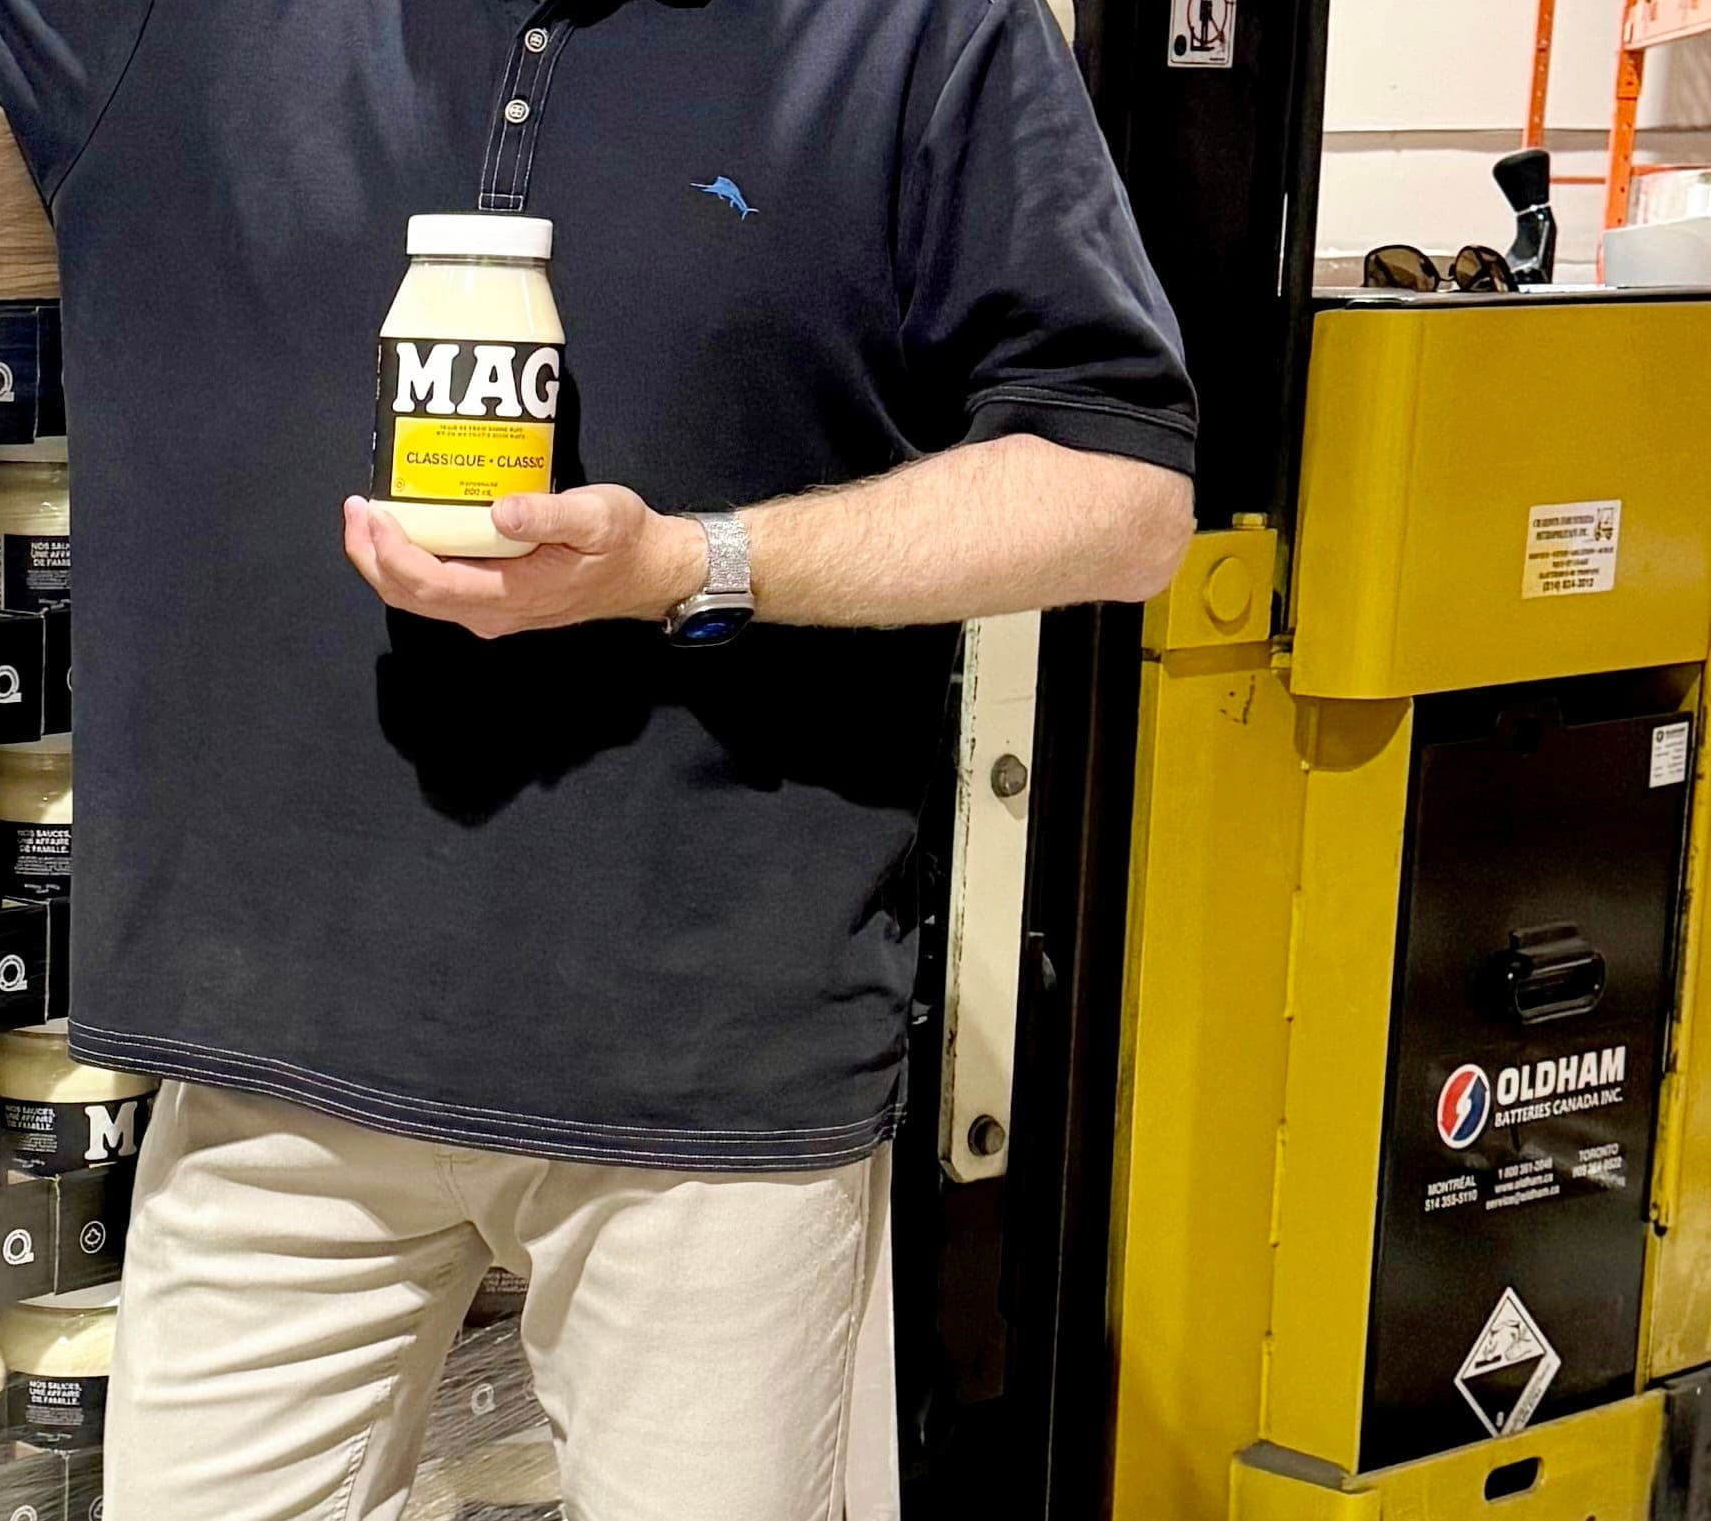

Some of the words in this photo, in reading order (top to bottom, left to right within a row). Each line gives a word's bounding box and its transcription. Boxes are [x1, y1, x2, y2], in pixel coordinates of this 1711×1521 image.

[392, 342, 560, 419] MAG
[407, 452, 486, 468] CLASSIQUE
[497, 455, 545, 469] CLASSIC
[1496, 1046, 1626, 1106] OLDHAM
[1494, 1101, 1551, 1128] BATTERIES
[1552, 1092, 1598, 1115] CANADA
[1600, 1087, 1624, 1105] INC.
[1578, 1142, 1620, 1162] TORONTO
[1427, 1174, 1477, 1196] MONTRÉAL
[1425, 1197, 1440, 1212] 514
